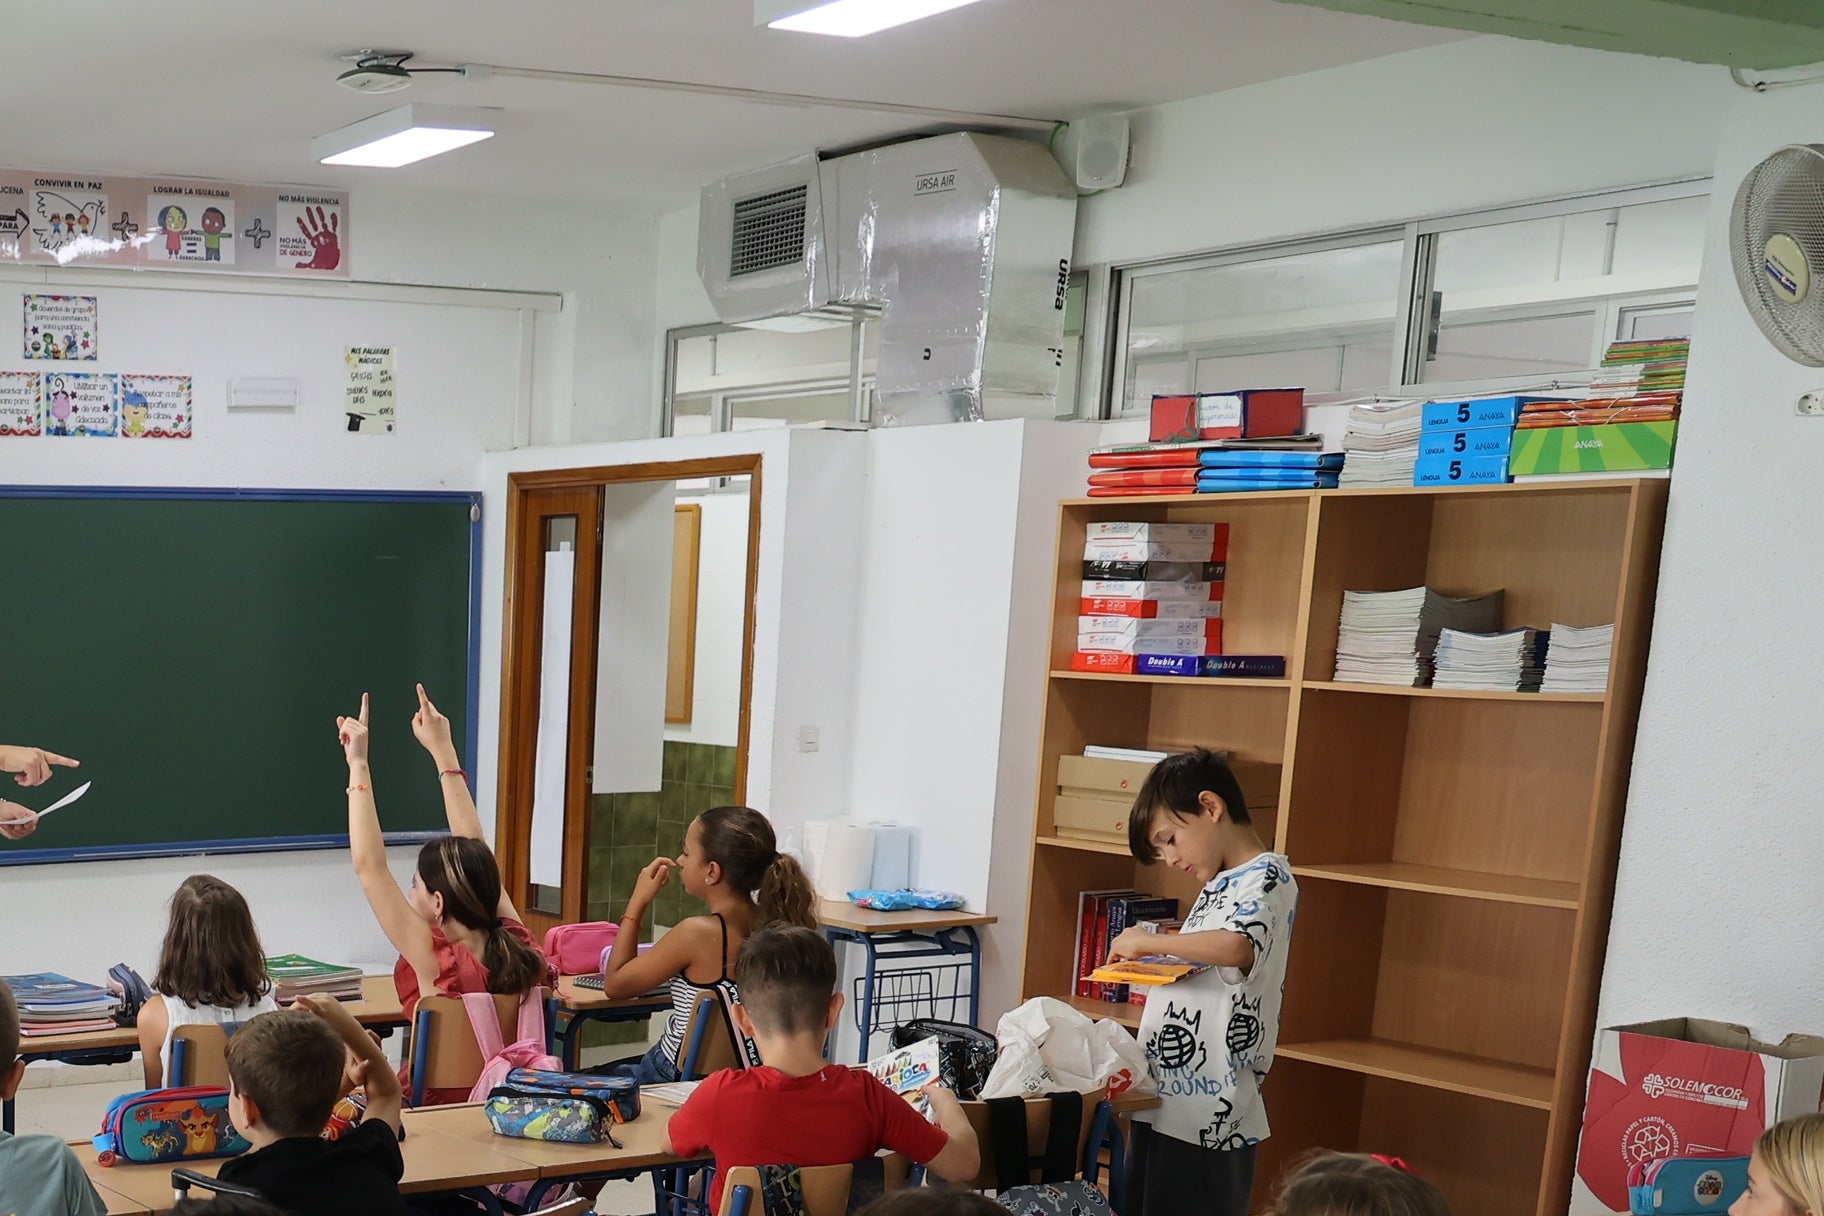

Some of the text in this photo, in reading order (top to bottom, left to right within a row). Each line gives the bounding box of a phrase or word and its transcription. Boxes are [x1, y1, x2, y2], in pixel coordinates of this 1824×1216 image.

[34, 178, 102, 190] CONVIVIR EN PAZ
[916, 174, 955, 191] URSA AIR
[153, 186, 230, 198] LOGRAR LA IGUALDAD
[290, 194, 305, 203] MÁS
[306, 196, 340, 205] VIOLENCIA
[292, 236, 307, 245] MÁS
[1428, 403, 1505, 426] LENGUA 5 ANAYA
[1425, 432, 1501, 455] LENGUA 5 ANAYA
[1573, 439, 1605, 449] ANAYA
[1420, 460, 1496, 482] LENGUA 5 ANAYA
[1148, 656, 1184, 667] Double A
[1206, 660, 1237, 670] Double
[1238, 660, 1246, 670] A
